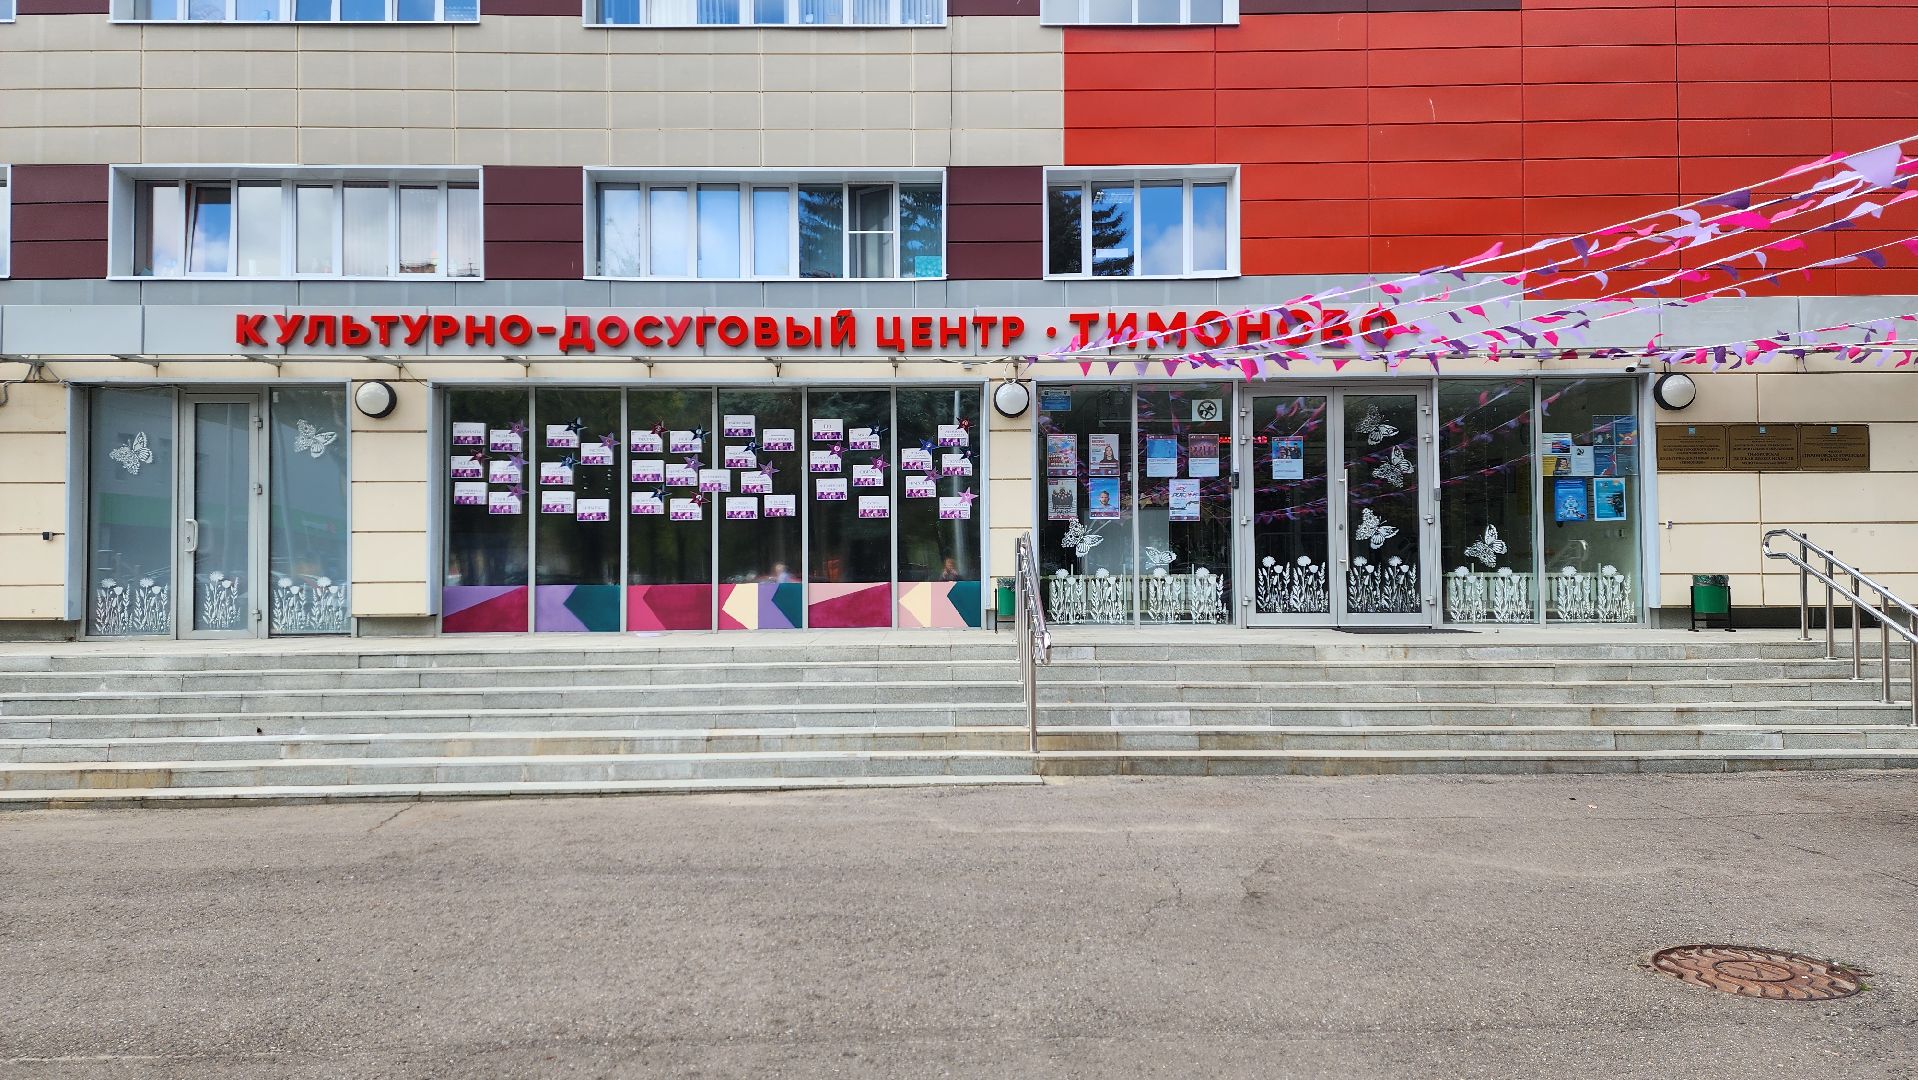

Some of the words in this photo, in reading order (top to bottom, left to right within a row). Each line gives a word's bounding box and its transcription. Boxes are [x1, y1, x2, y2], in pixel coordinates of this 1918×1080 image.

[236, 310, 857, 352] КУЛЬТУРНО-ДОСУГОВЫЙ
[876, 316, 1025, 352] ЦЕНТР
[1069, 307, 1397, 349] ТИМОНОВО
